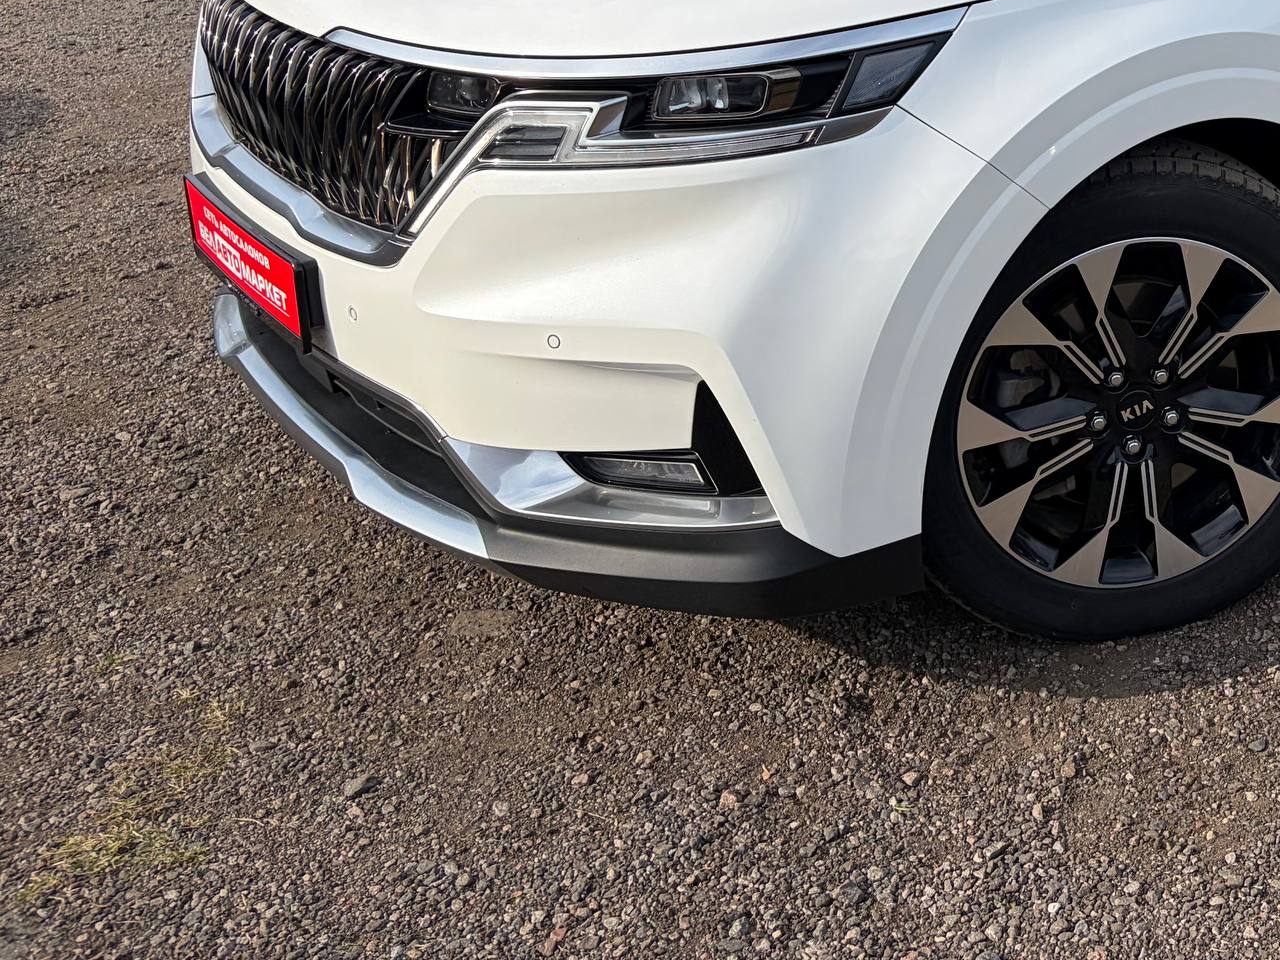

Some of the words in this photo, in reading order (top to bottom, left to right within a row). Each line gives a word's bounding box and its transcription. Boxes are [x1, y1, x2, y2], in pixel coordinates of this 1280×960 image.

[198, 220, 217, 251] БЕЛ
[216, 234, 241, 274] АВТО
[241, 260, 288, 311] МАРКЕТ
[203, 206, 219, 229] СЕТЬ
[219, 221, 271, 270] АВТОСАЛОНОВ
[1120, 400, 1154, 422] KIA
